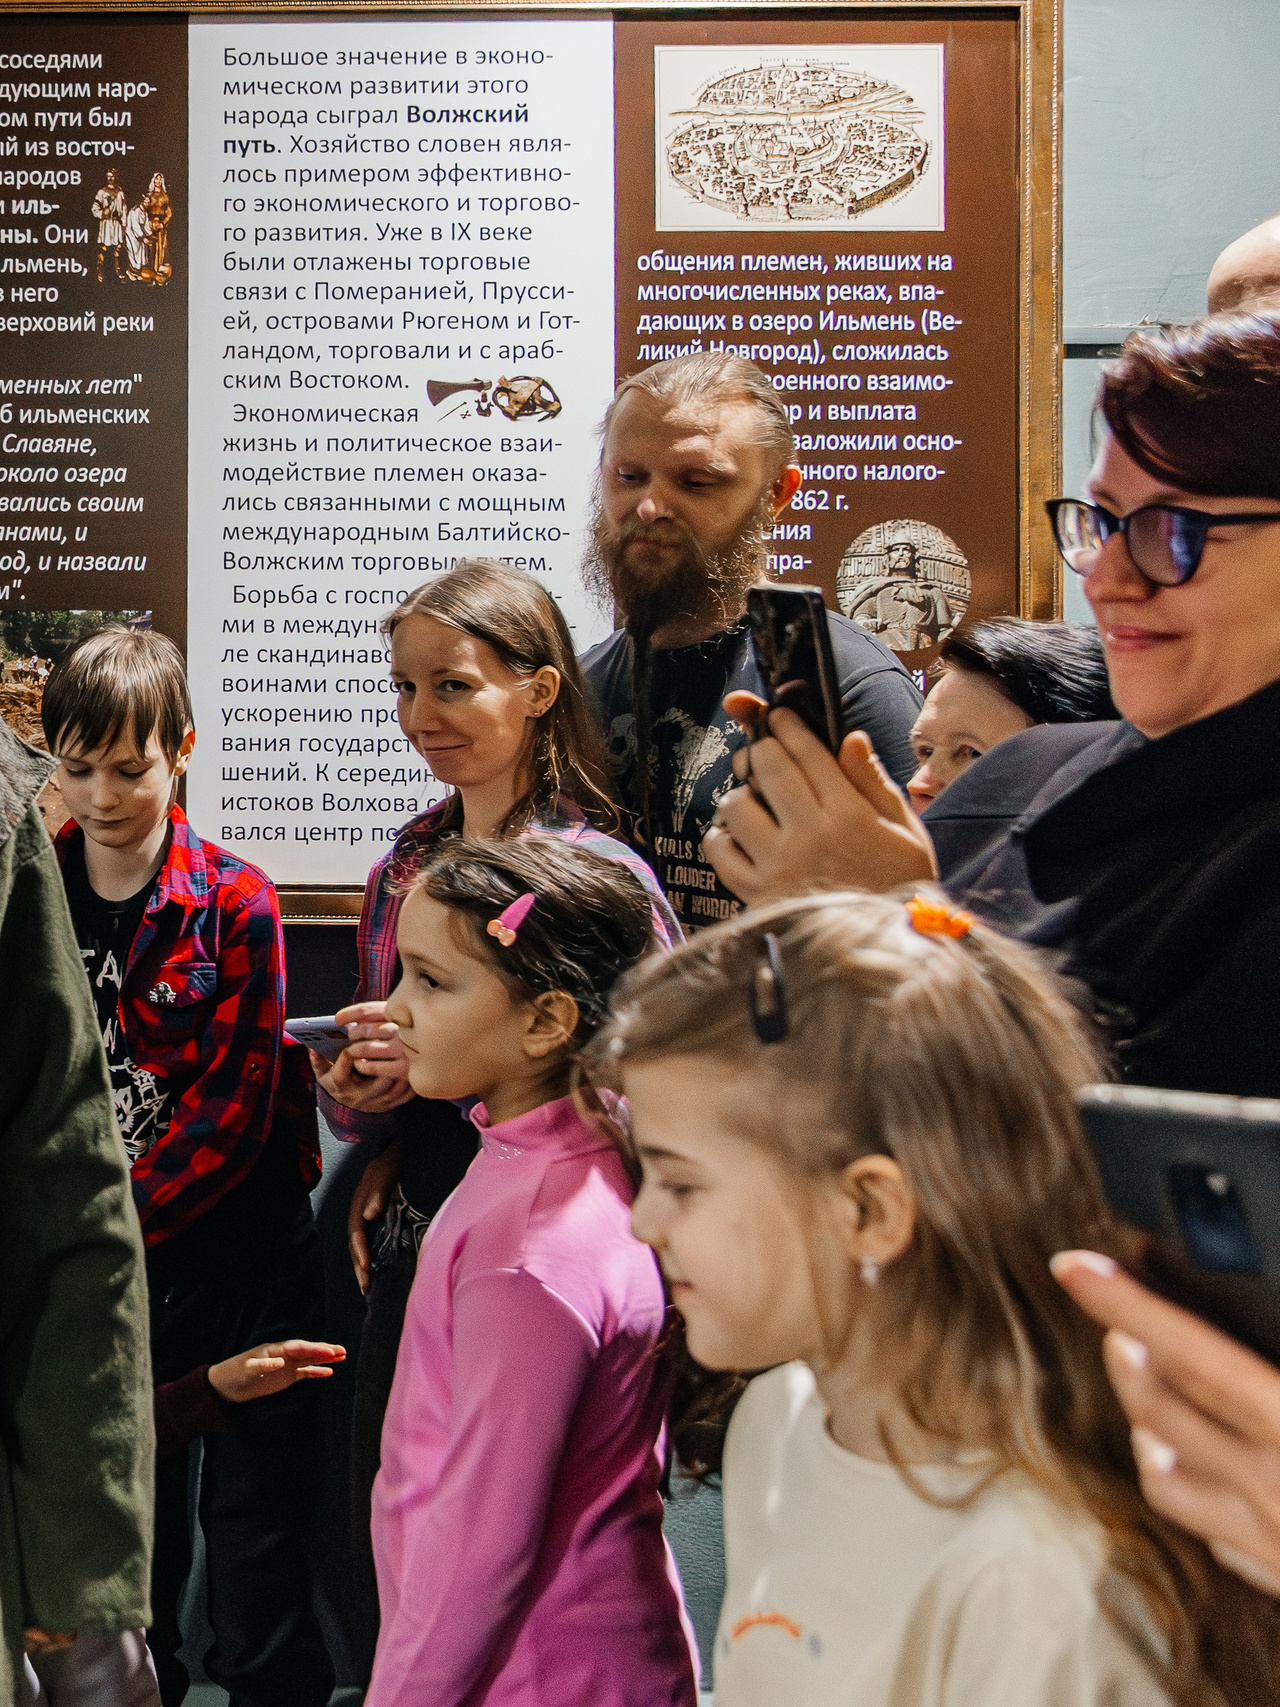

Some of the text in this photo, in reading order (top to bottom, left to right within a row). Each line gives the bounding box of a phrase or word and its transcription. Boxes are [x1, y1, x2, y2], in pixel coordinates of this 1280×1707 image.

[223, 47, 554, 67] Большое значение в эконо-
[223, 79, 529, 100] мическом развитии этого
[34, 111, 82, 132] пути
[88, 105, 132, 128] был
[223, 102, 529, 129] народа сыграл Волжский
[24, 140, 50, 157] из
[55, 140, 135, 157] восточ-
[223, 133, 572, 159] путь. Хозяйство словен явля-
[44, 223, 89, 244] Они
[223, 222, 533, 247] го развития. Уже в IX веке
[637, 248, 953, 276] общения племен, живших на
[10, 286, 59, 303] него
[222, 279, 575, 305] связи с Померанией, Прусси-
[637, 284, 945, 306] многочисленных реках, впа-
[636, 308, 964, 336] дающих в озеро Ильмень (Ве-
[831, 344, 950, 361] сложилась
[84, 372, 143, 395] лет"
[222, 369, 410, 389] ским Востоком.
[866, 374, 954, 391] взаимо-
[19, 408, 150, 424] ильменских
[232, 403, 419, 423] Экономическая
[808, 404, 917, 421] и выплата
[222, 437, 563, 453] жизнь и политическое взаи-
[793, 433, 963, 452] заложили осно-
[222, 461, 547, 486] модействие племен оказа-
[863, 464, 946, 481] налого-
[77, 496, 145, 513] своим
[790, 489, 849, 511] 862 г.
[222, 521, 571, 546] международным Балтийско-
[37, 555, 52, 571] и
[56, 555, 147, 572] назвали
[221, 792, 418, 813] истоков Волхова
[666, 865, 716, 891] LOUDER
